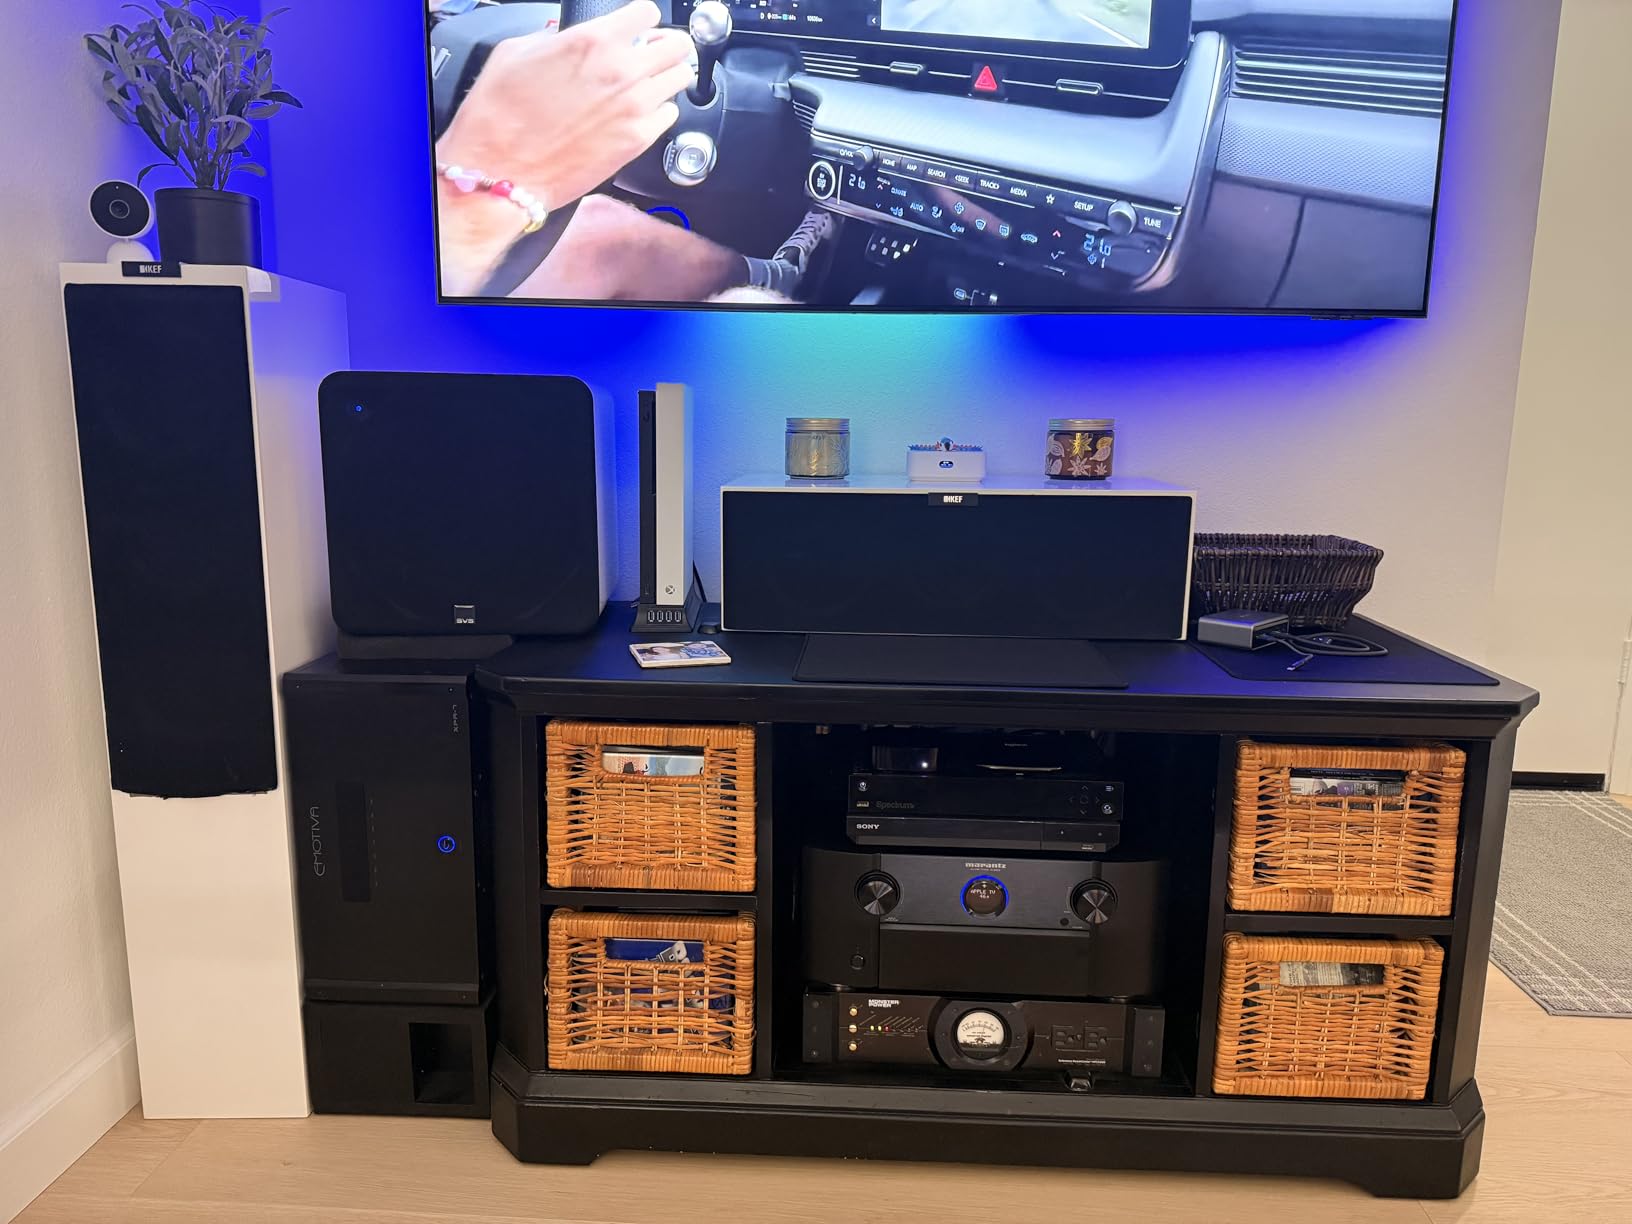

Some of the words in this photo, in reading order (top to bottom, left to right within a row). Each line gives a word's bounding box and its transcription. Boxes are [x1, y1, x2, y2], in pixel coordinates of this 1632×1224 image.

[882, 158, 896, 167] HOME
[927, 167, 946, 179] SEARCH
[1009, 187, 1028, 197] MEDIA
[910, 202, 924, 212] AUTO
[1073, 201, 1094, 212] SETUP
[1143, 216, 1162, 228] TUNE
[146, 265, 162, 273] KEF
[949, 495, 963, 503] KEF
[876, 800, 914, 810] Spectrum
[309, 806, 326, 877] EMOTIVA
